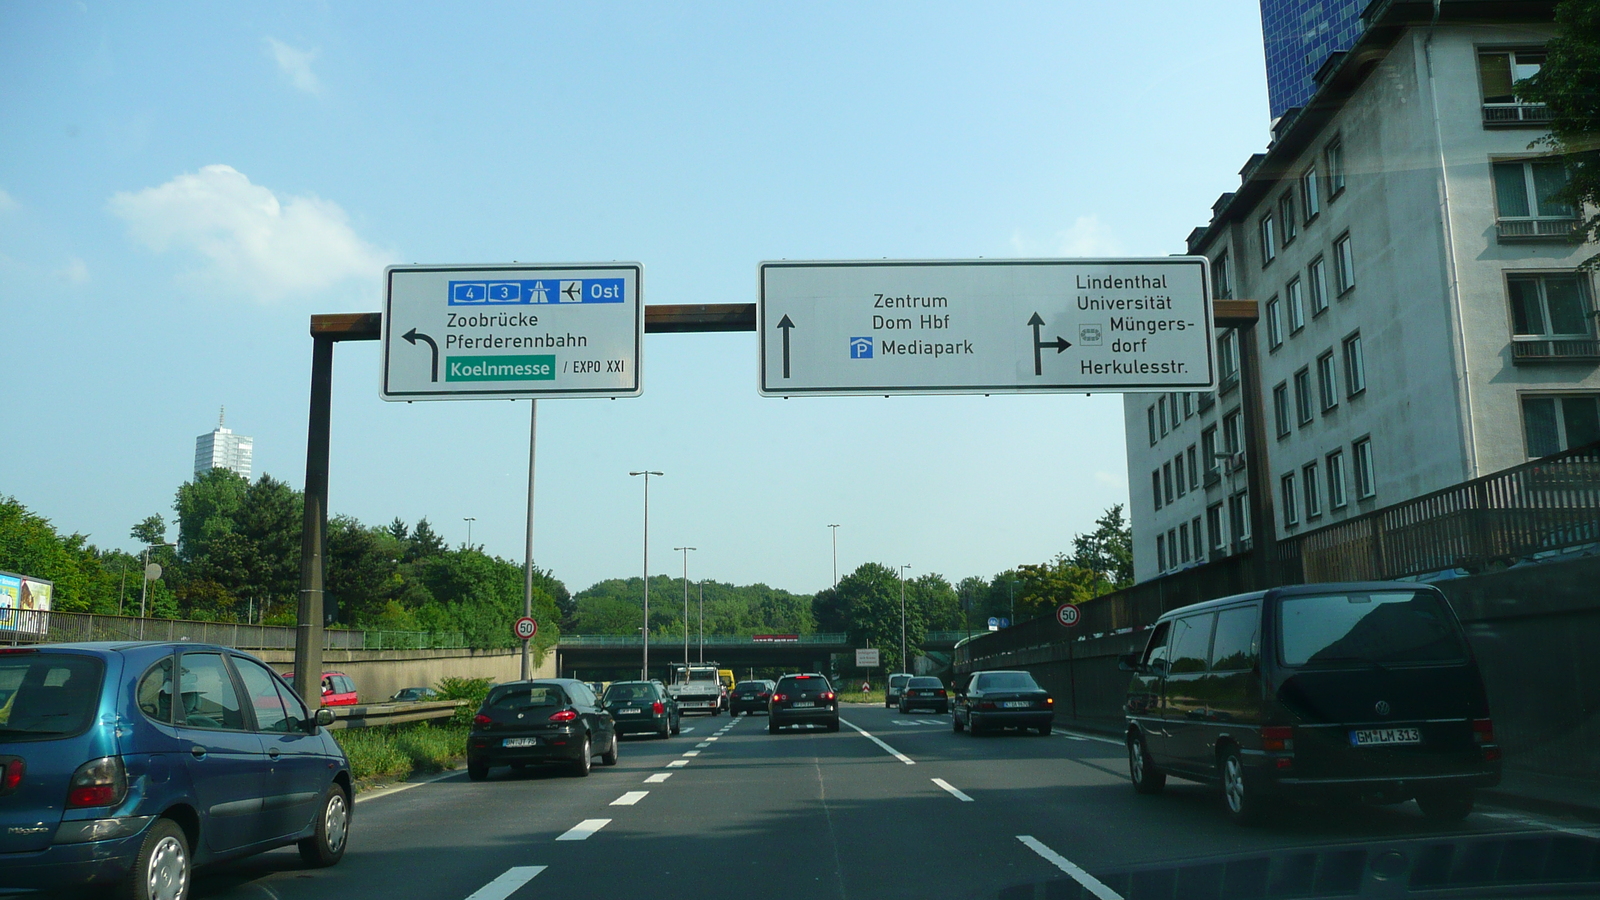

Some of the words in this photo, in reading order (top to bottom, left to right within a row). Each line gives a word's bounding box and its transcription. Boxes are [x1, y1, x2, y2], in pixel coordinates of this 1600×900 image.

[1076, 274, 1168, 290] Lindenthal
[466, 287, 474, 299] 4
[501, 287, 508, 299] 3
[590, 283, 619, 299] Ost
[873, 293, 948, 309] Zentrum
[1077, 295, 1172, 311] Universität
[447, 312, 538, 328] Zoobrücke
[872, 315, 912, 330] Dom
[919, 314, 950, 329] Hbf
[1110, 316, 1195, 335] Müngers-
[446, 333, 588, 349] Pferderennbahn
[881, 339, 974, 359] Mediapark
[1111, 338, 1147, 353] dorf
[450, 360, 550, 377] Koelnmesse
[573, 360, 601, 374] EXPO
[606, 360, 625, 373] XXI
[1080, 359, 1188, 375] Herkulesstr.
[1062, 609, 1076, 621] 50
[520, 622, 533, 634] 50
[1356, 731, 1373, 743] GM
[1379, 730, 1396, 742] LM
[1397, 729, 1419, 741] 313
